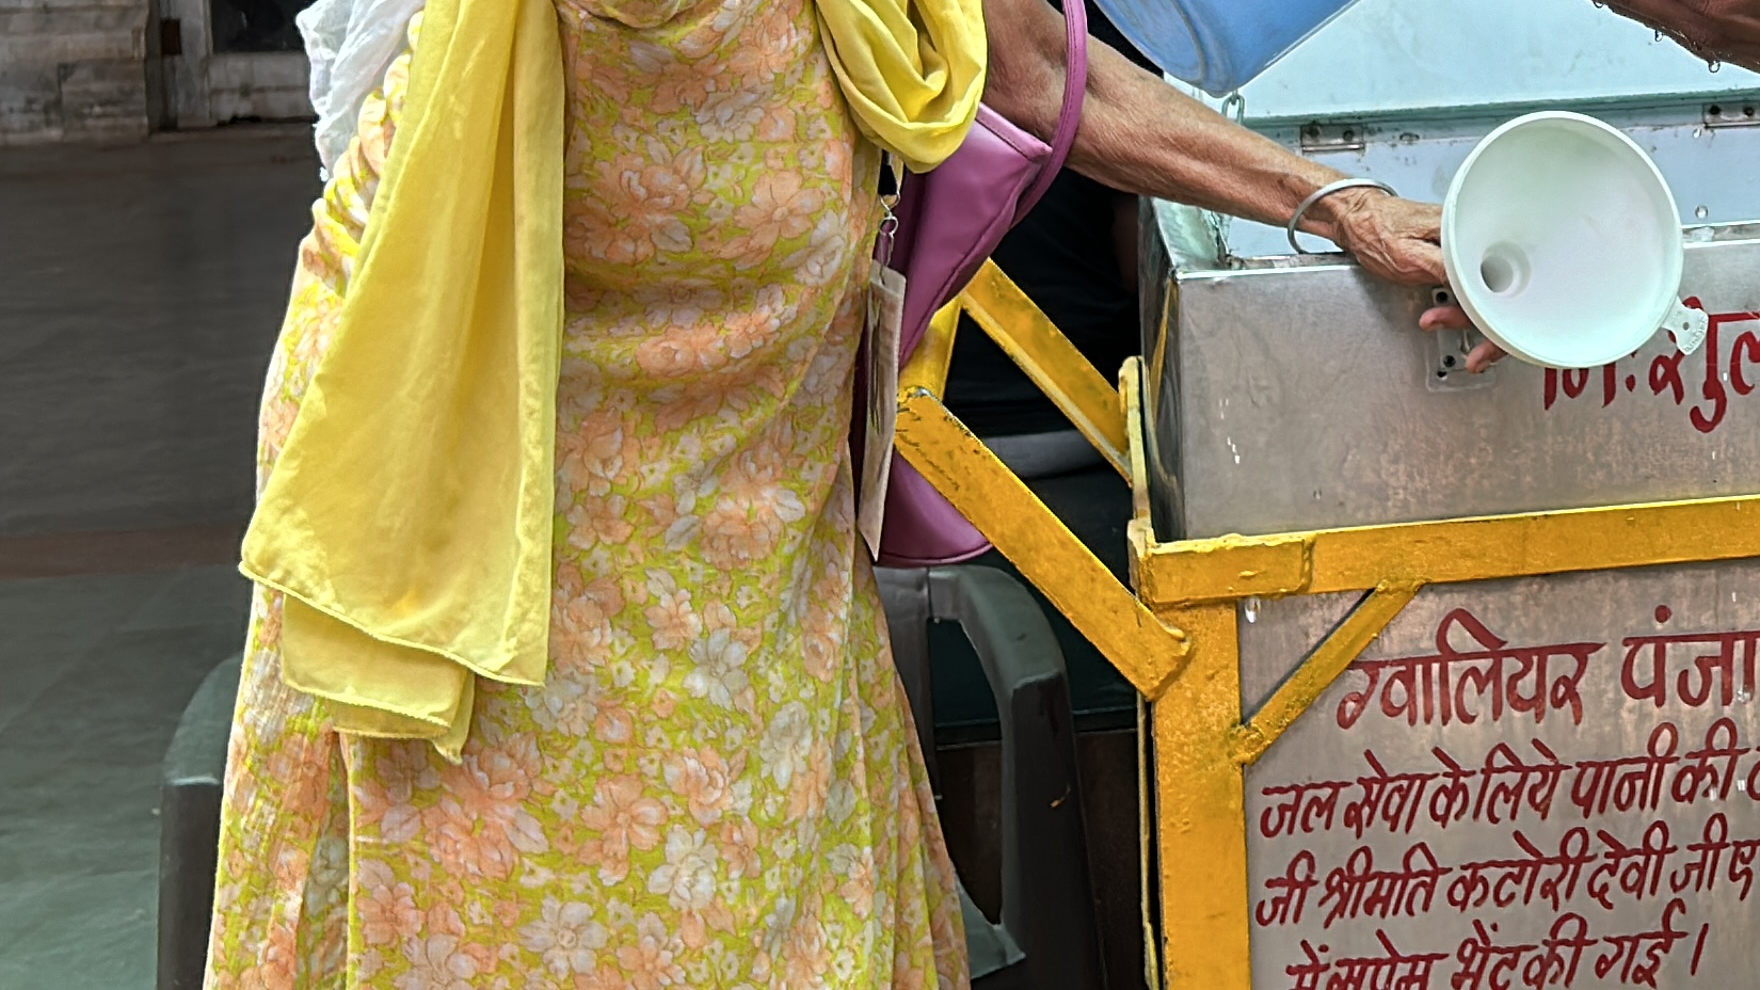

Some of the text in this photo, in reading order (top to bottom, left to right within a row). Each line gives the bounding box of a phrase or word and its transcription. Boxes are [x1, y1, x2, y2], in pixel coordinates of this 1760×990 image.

[1337, 607, 1606, 730] ग्वालियर
[1259, 780, 1353, 839] जल
[1343, 748, 1441, 839] सेवा
[1429, 745, 1477, 829] के
[1472, 737, 1573, 825] लिये
[1570, 722, 1681, 819] पानी
[1670, 716, 1751, 804] की
[1255, 849, 1319, 927] जी
[1318, 841, 1452, 929] श्रीमति
[1446, 826, 1598, 913] कटोरी
[1586, 819, 1678, 911] देवी
[1669, 812, 1731, 894] जी
[1522, 912, 1598, 990] की
